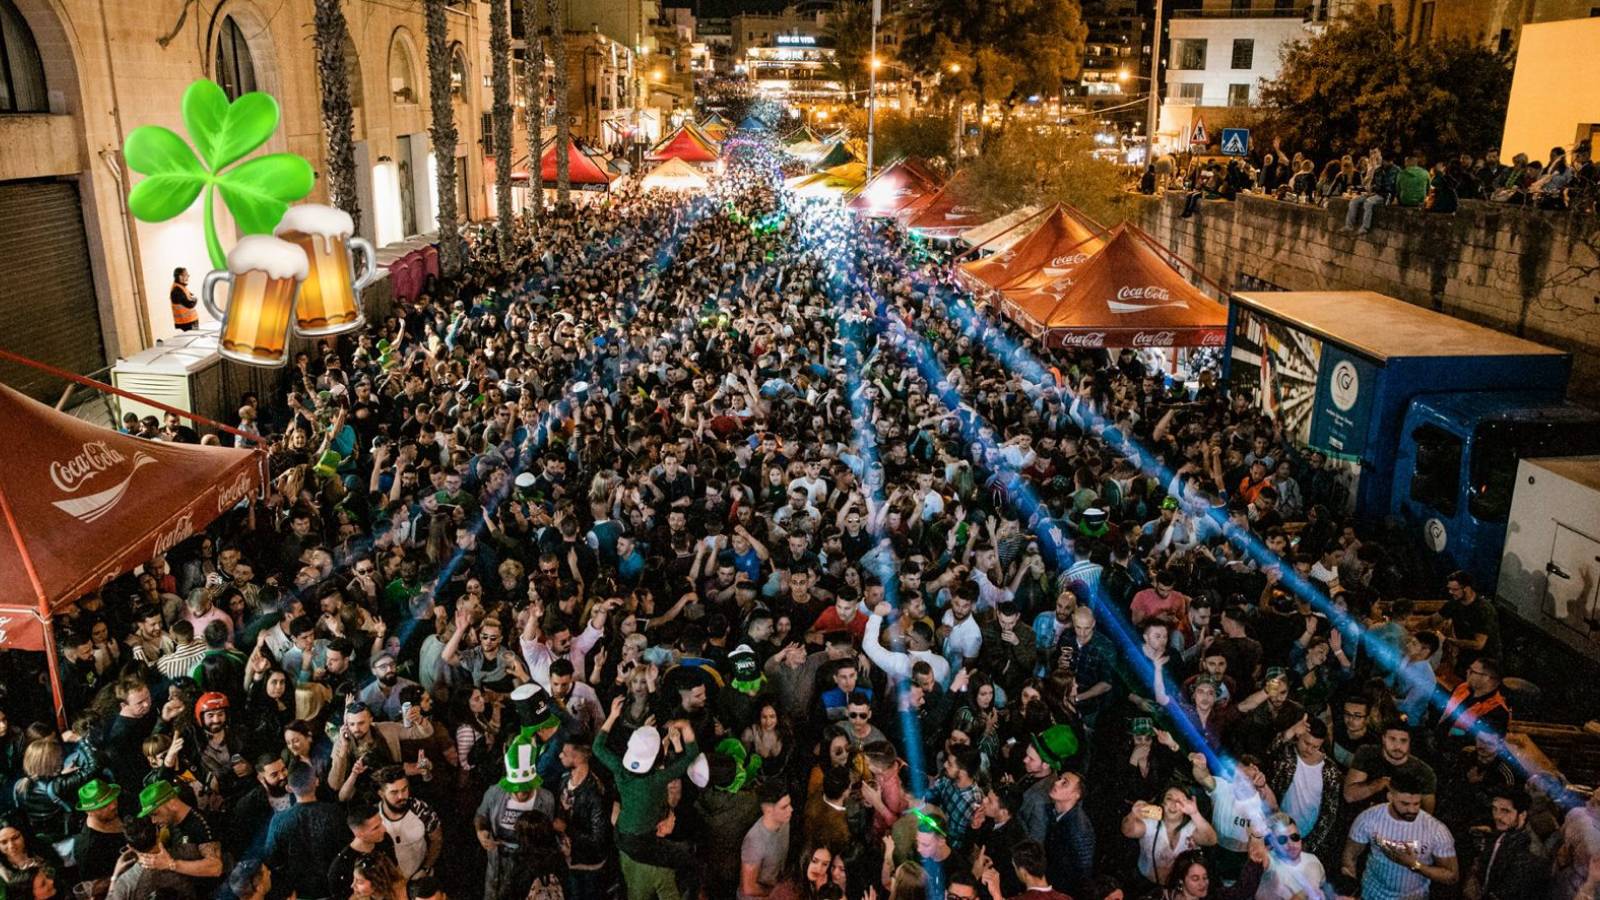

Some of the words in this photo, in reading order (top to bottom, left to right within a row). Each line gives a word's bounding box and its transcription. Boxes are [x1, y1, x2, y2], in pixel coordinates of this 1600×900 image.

[1052, 253, 1089, 267] Coca-Co
[1117, 285, 1170, 301] Coca-Cola
[1062, 332, 1106, 347] Coca-Cola
[1132, 331, 1176, 346] Coca-Cola
[49, 440, 126, 493] Coca-Cola
